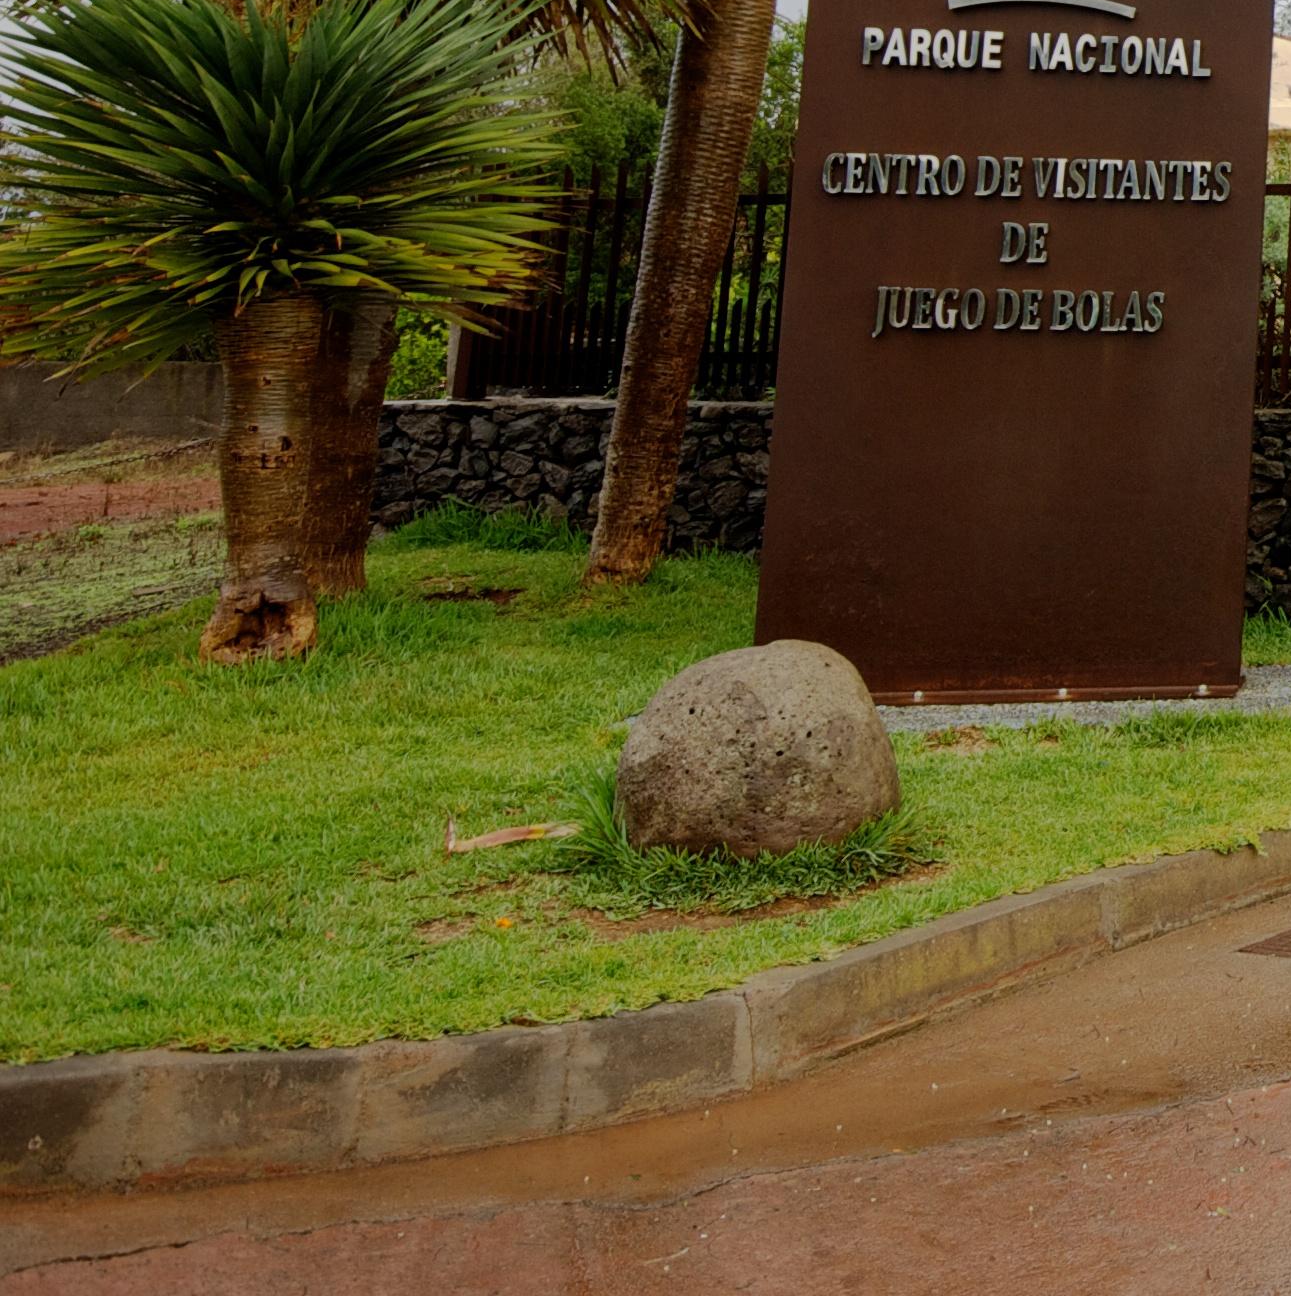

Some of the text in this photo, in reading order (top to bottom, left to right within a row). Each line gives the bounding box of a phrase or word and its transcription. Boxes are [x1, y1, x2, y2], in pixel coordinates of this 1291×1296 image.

[862, 27, 1212, 77] PARQUE NACIONAL
[822, 152, 1232, 202] CENTRO DE VISITANTES
[999, 222, 1049, 264] DE
[871, 286, 1165, 338] JUEGO DE BOLAS
